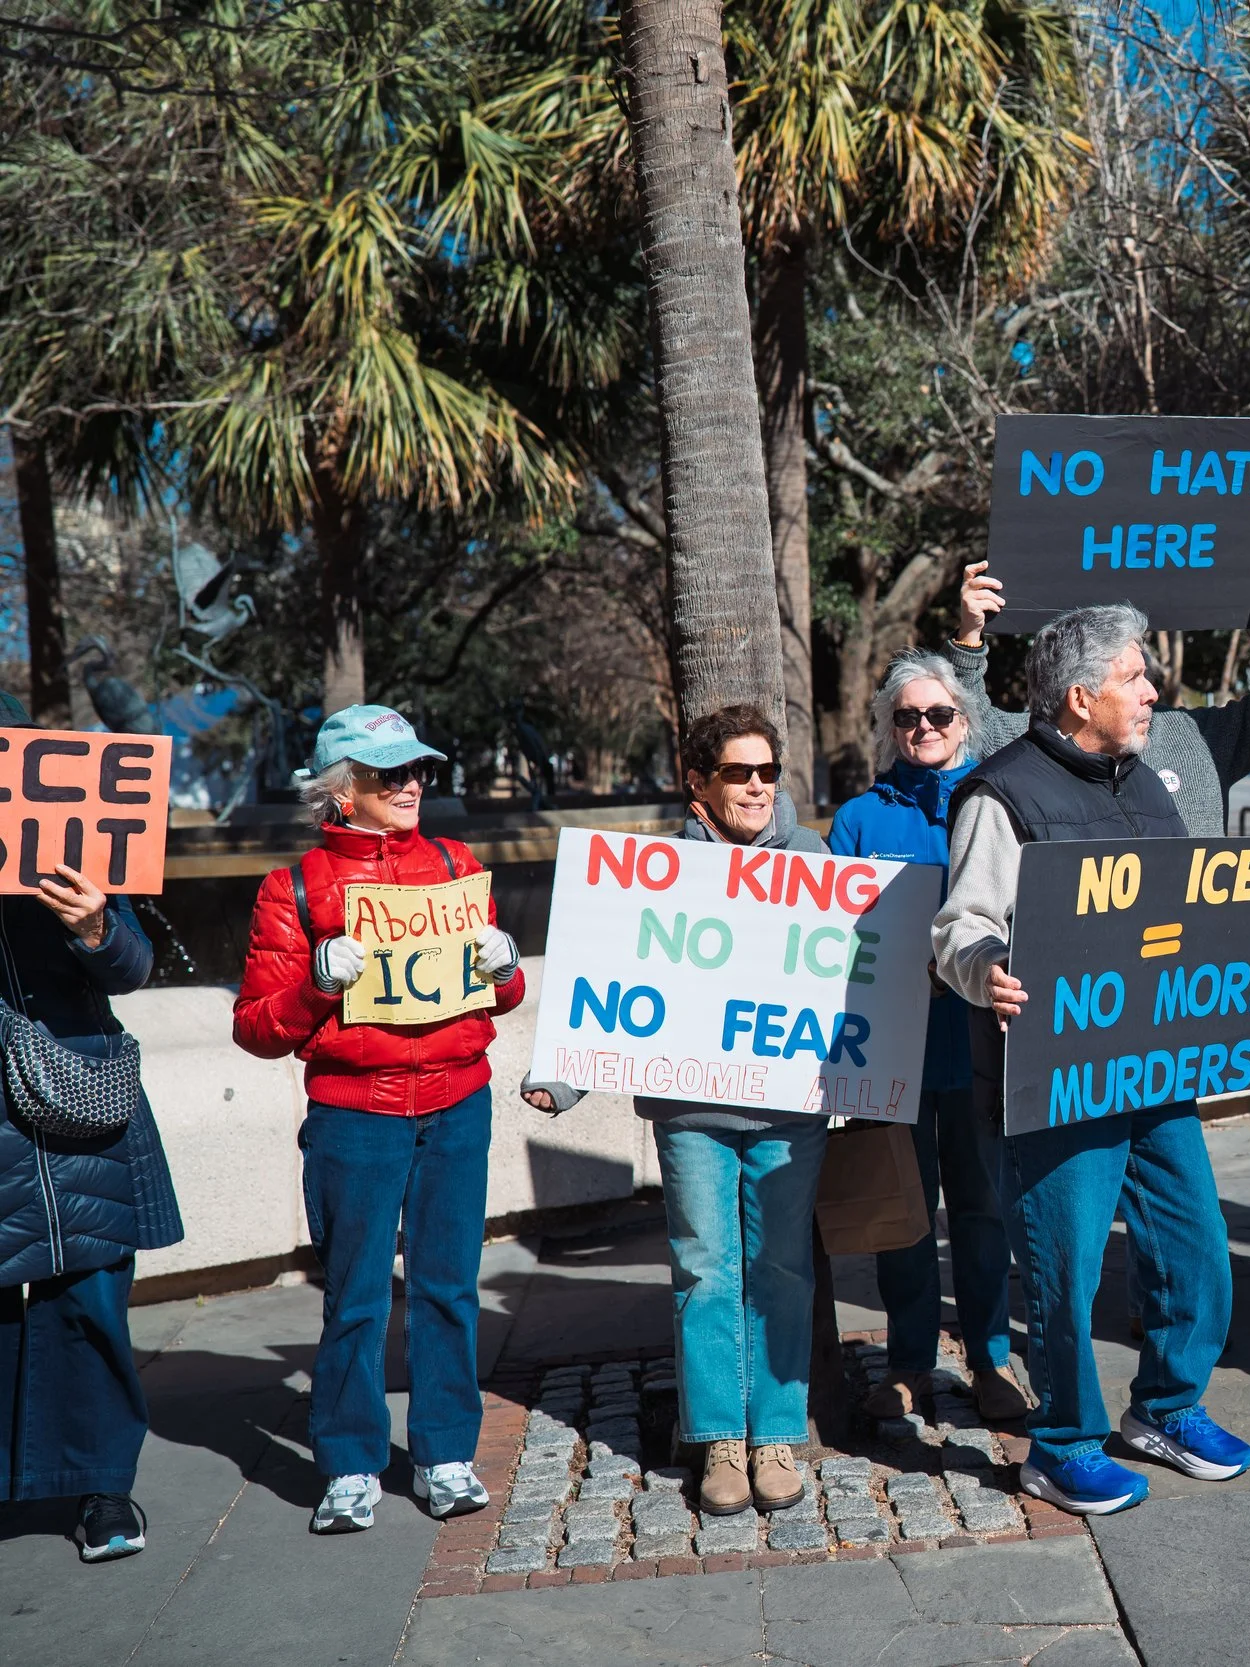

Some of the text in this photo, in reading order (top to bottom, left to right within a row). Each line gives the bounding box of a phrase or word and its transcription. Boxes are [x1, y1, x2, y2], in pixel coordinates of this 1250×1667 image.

[1020, 450, 1104, 496] NO
[1082, 523, 1217, 571] HERE
[0, 817, 147, 888] UT
[585, 833, 880, 915] NO KING
[1076, 852, 1142, 916] NO
[353, 890, 487, 944] Abolish
[636, 907, 881, 985] NO ICE
[568, 976, 871, 1068] NO FEAR
[1053, 971, 1126, 1035] NO
[555, 1046, 906, 1117] WELCOME ALL!
